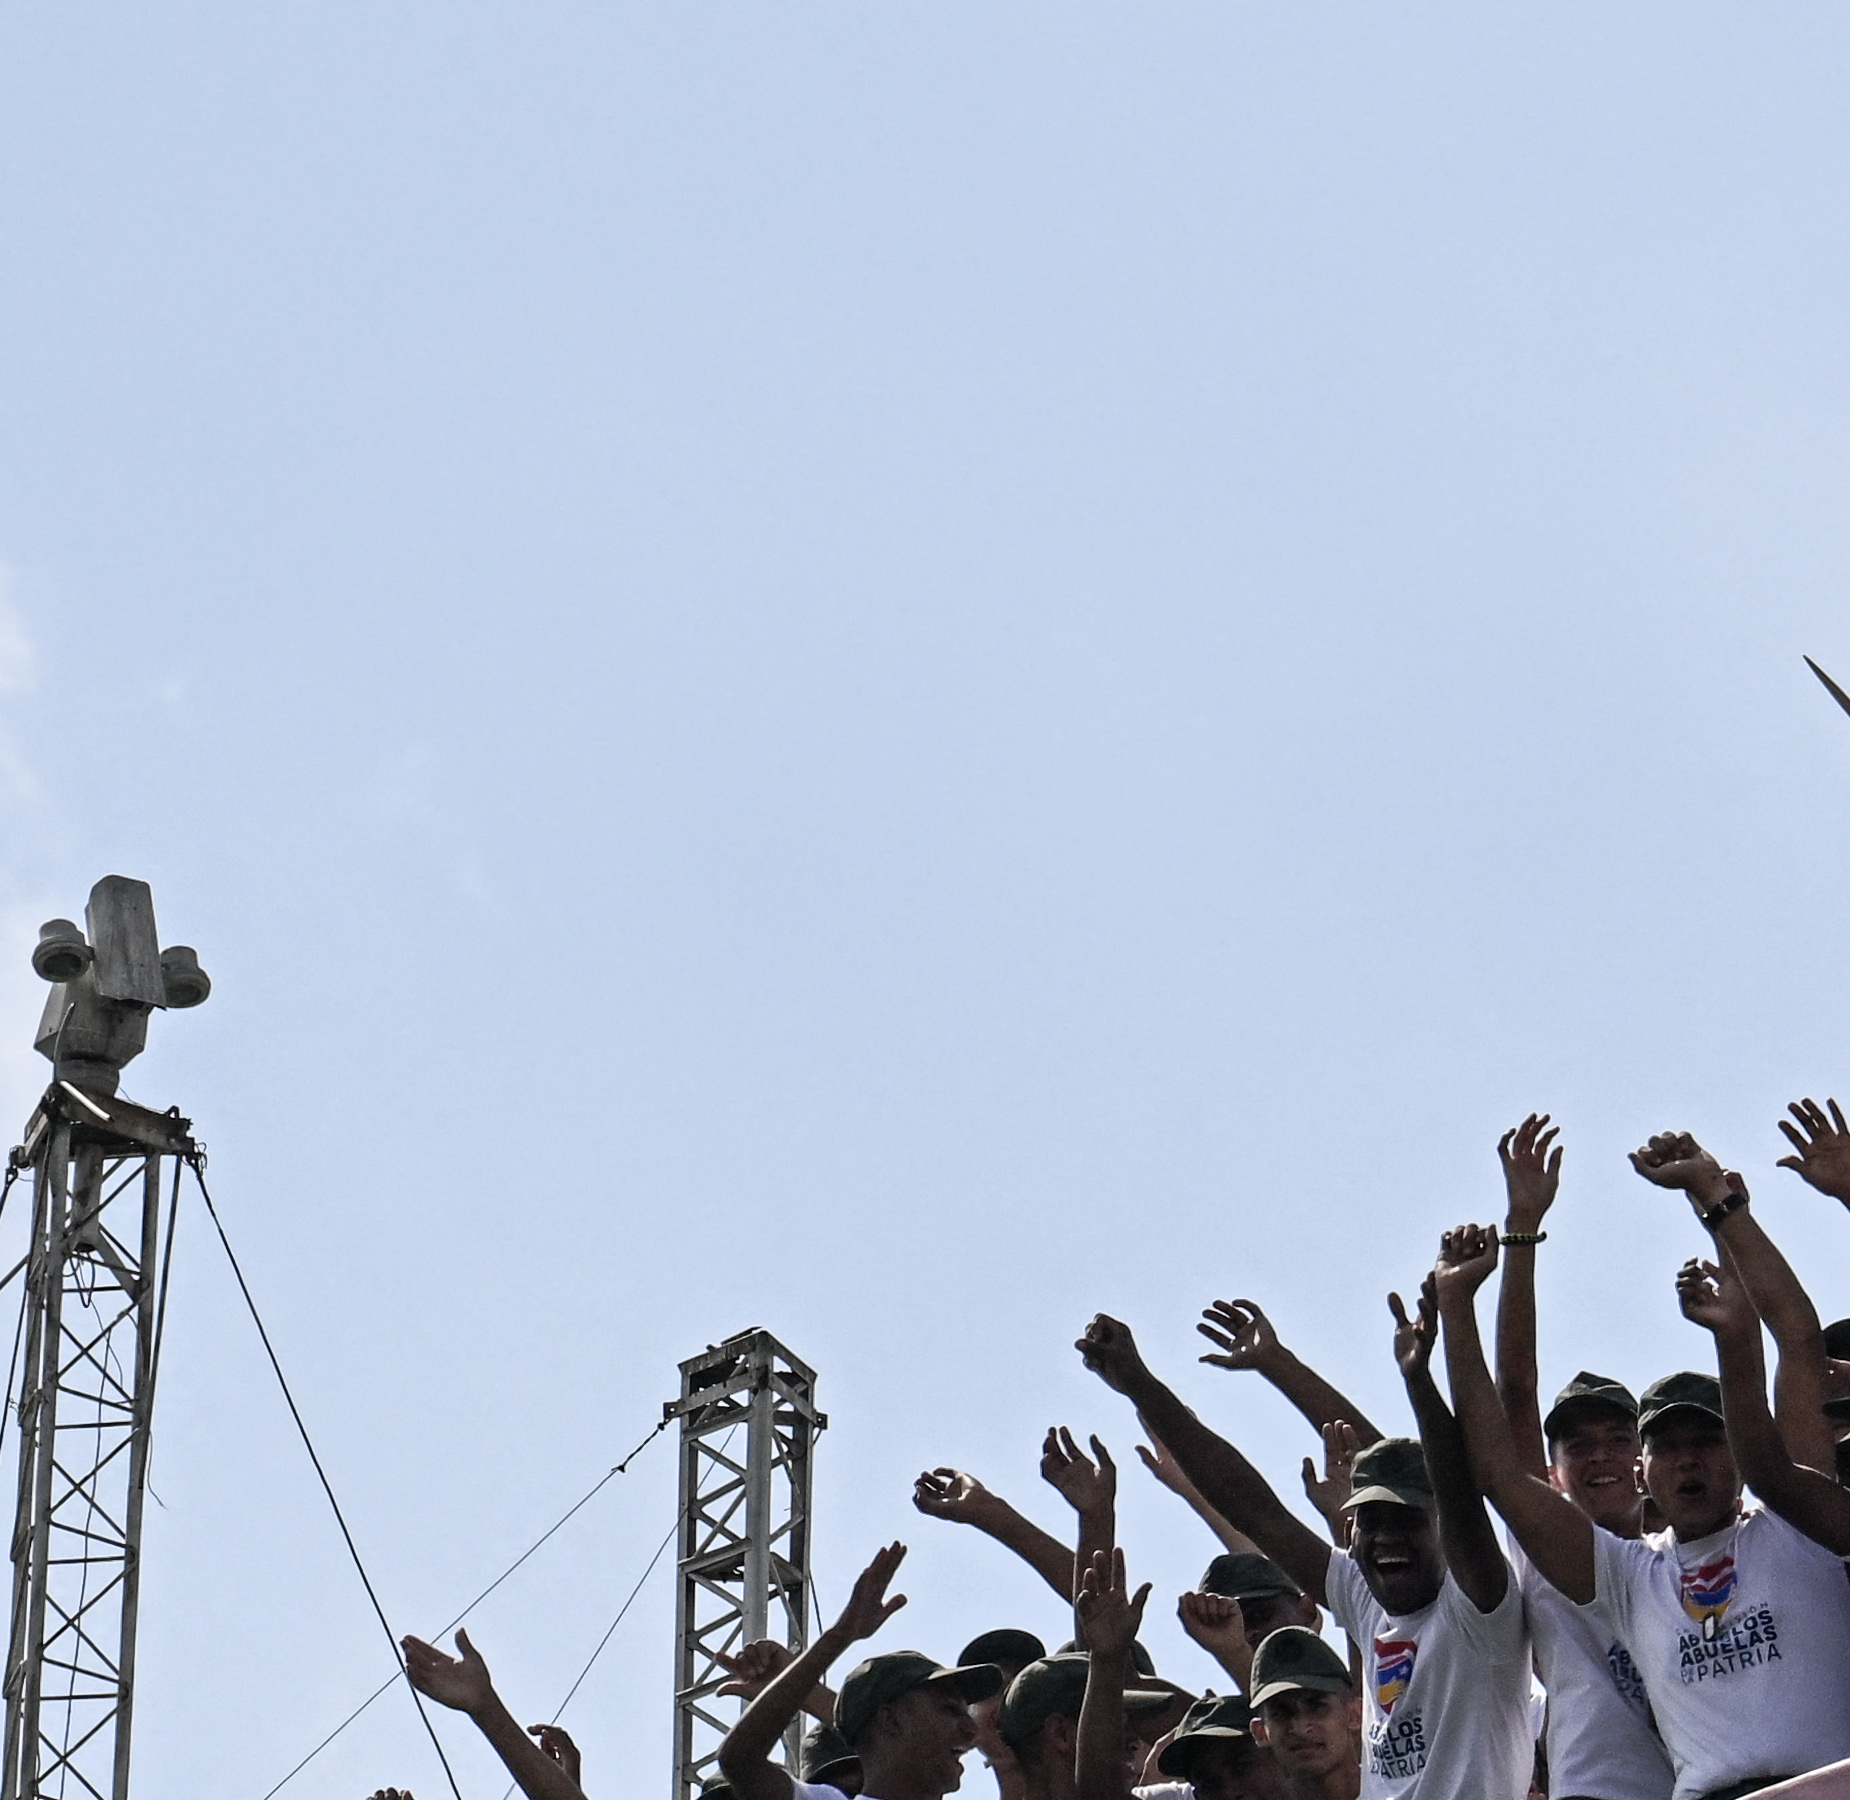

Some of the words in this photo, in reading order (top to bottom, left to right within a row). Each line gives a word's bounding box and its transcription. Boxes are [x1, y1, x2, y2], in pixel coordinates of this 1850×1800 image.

[1679, 1610, 1773, 1653] ABLOS
[1681, 1625, 1778, 1668] ABUELAS
[1697, 1643, 1782, 1681] PATRIA
